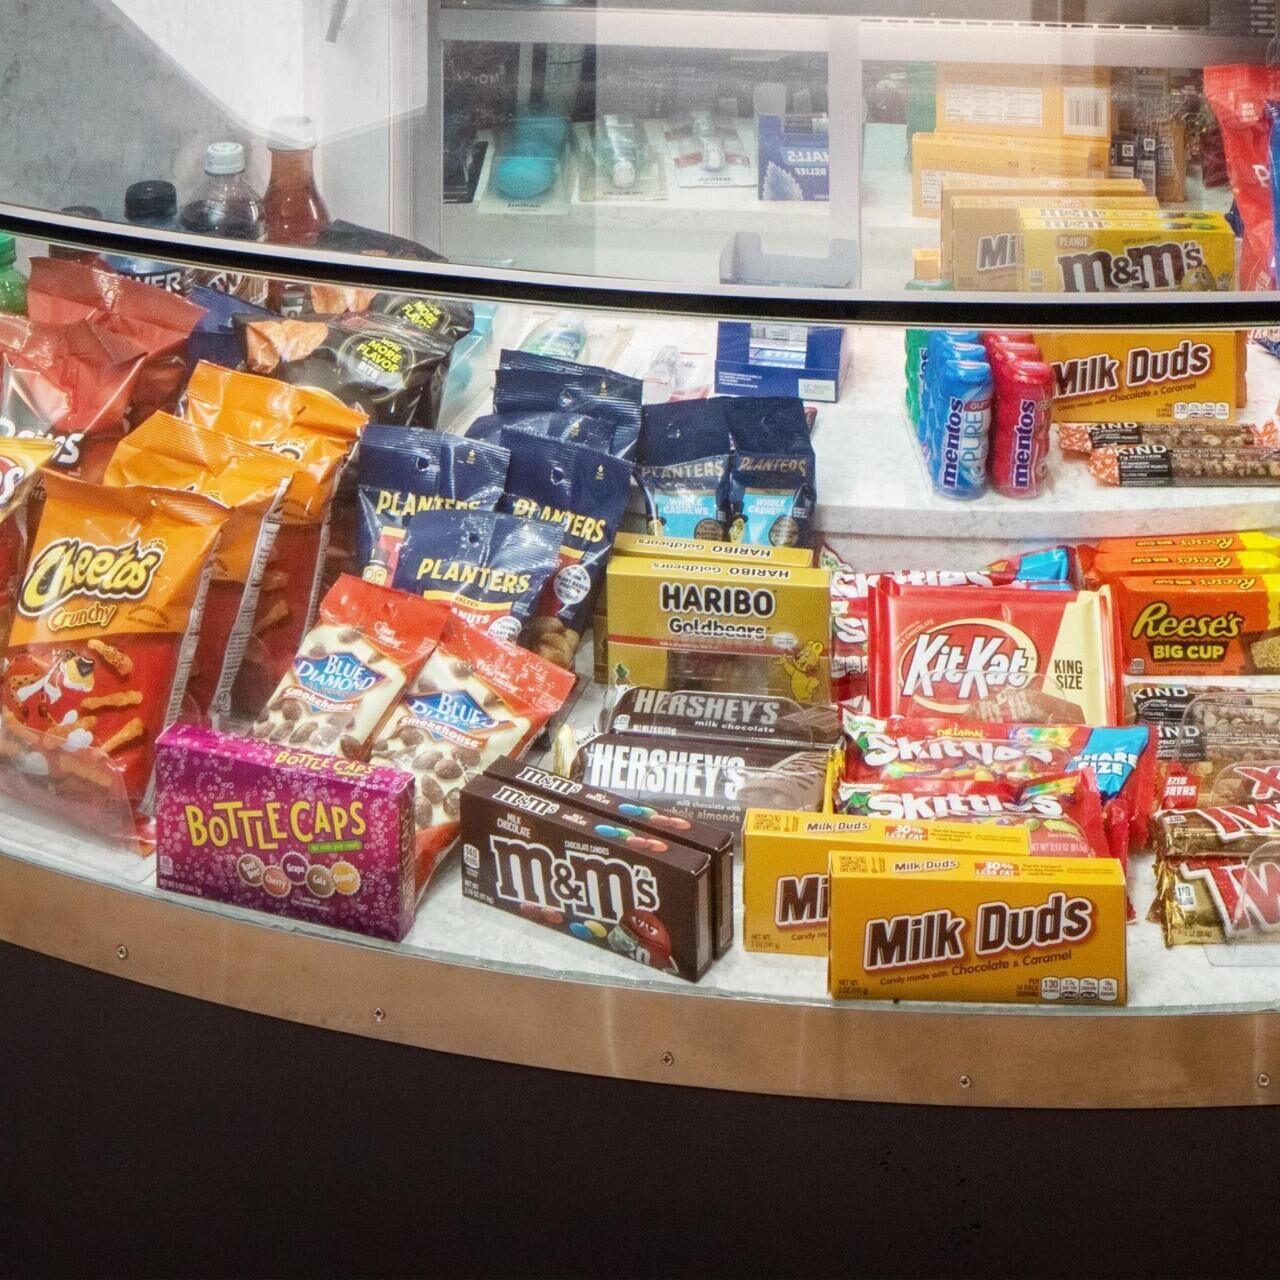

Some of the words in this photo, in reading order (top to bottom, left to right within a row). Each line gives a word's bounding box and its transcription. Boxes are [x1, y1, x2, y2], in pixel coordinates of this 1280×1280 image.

[1059, 237, 1089, 248] PEANUT
[356, 343, 400, 373] FLAVOR
[368, 340, 402, 363] MORE
[357, 361, 381, 380] BITE
[1051, 354, 1120, 399] Milk
[1127, 339, 1213, 388] Duds
[1109, 389, 1152, 403] Chocolate
[1160, 381, 1197, 395] Caramel
[942, 396, 964, 489] mentos
[1013, 399, 1036, 489] mentos
[1114, 445, 1168, 455] KIND
[641, 459, 725, 479] PLANTERS
[712, 544, 772, 558] HARIBO
[20, 537, 165, 616] Cheetos
[416, 558, 532, 594] PLANTERS
[652, 561, 722, 574] Goldbears
[728, 567, 790, 580] HARIBO
[661, 583, 774, 617] HARIBO
[47, 602, 118, 632] Crunchy
[669, 617, 766, 640] Goldbears
[1132, 602, 1245, 639] Reese's
[1153, 645, 1183, 659] BIG
[1186, 645, 1224, 659] CUP
[295, 661, 377, 692] DIAMOND
[324, 654, 365, 680] BLUE
[1054, 659, 1083, 674] KING
[1056, 674, 1083, 690] SIZE
[282, 687, 356, 711] Smokehouse
[1131, 687, 1189, 702] KIND
[437, 692, 486, 727] BLUE
[633, 689, 780, 725] HERSHEY'S
[400, 716, 483, 749] Smokehouse
[695, 720, 718, 729] milk
[721, 722, 775, 733] chocolate
[937, 728, 985, 738] ORIGINAL
[864, 732, 1053, 767] Skittles
[1071, 751, 1138, 767] SHARE
[274, 751, 330, 771] BOTTLE
[332, 759, 377, 775] CAPS
[590, 742, 747, 801] HERSHEY'S
[1077, 762, 1124, 776] SIZE
[692, 801, 725, 811] chocolate
[698, 808, 741, 824] almonds
[184, 801, 288, 850] BOTTLE
[289, 801, 368, 843] CAPS
[497, 817, 532, 839] CHOCOLATE
[506, 812, 522, 826] MILK
[806, 822, 833, 832] Milk
[835, 821, 870, 832] Duds
[894, 861, 922, 872] Milk
[924, 860, 959, 870] Duds
[777, 875, 829, 926] Mi
[866, 910, 964, 971] Milk
[977, 894, 1094, 956] Duds
[880, 977, 906, 987] Candy
[907, 973, 930, 983] made
[931, 969, 949, 979] with
[951, 959, 1010, 977] Chocolate
[1022, 951, 1073, 968] Caramel
[1043, 980, 1059, 989] 130
